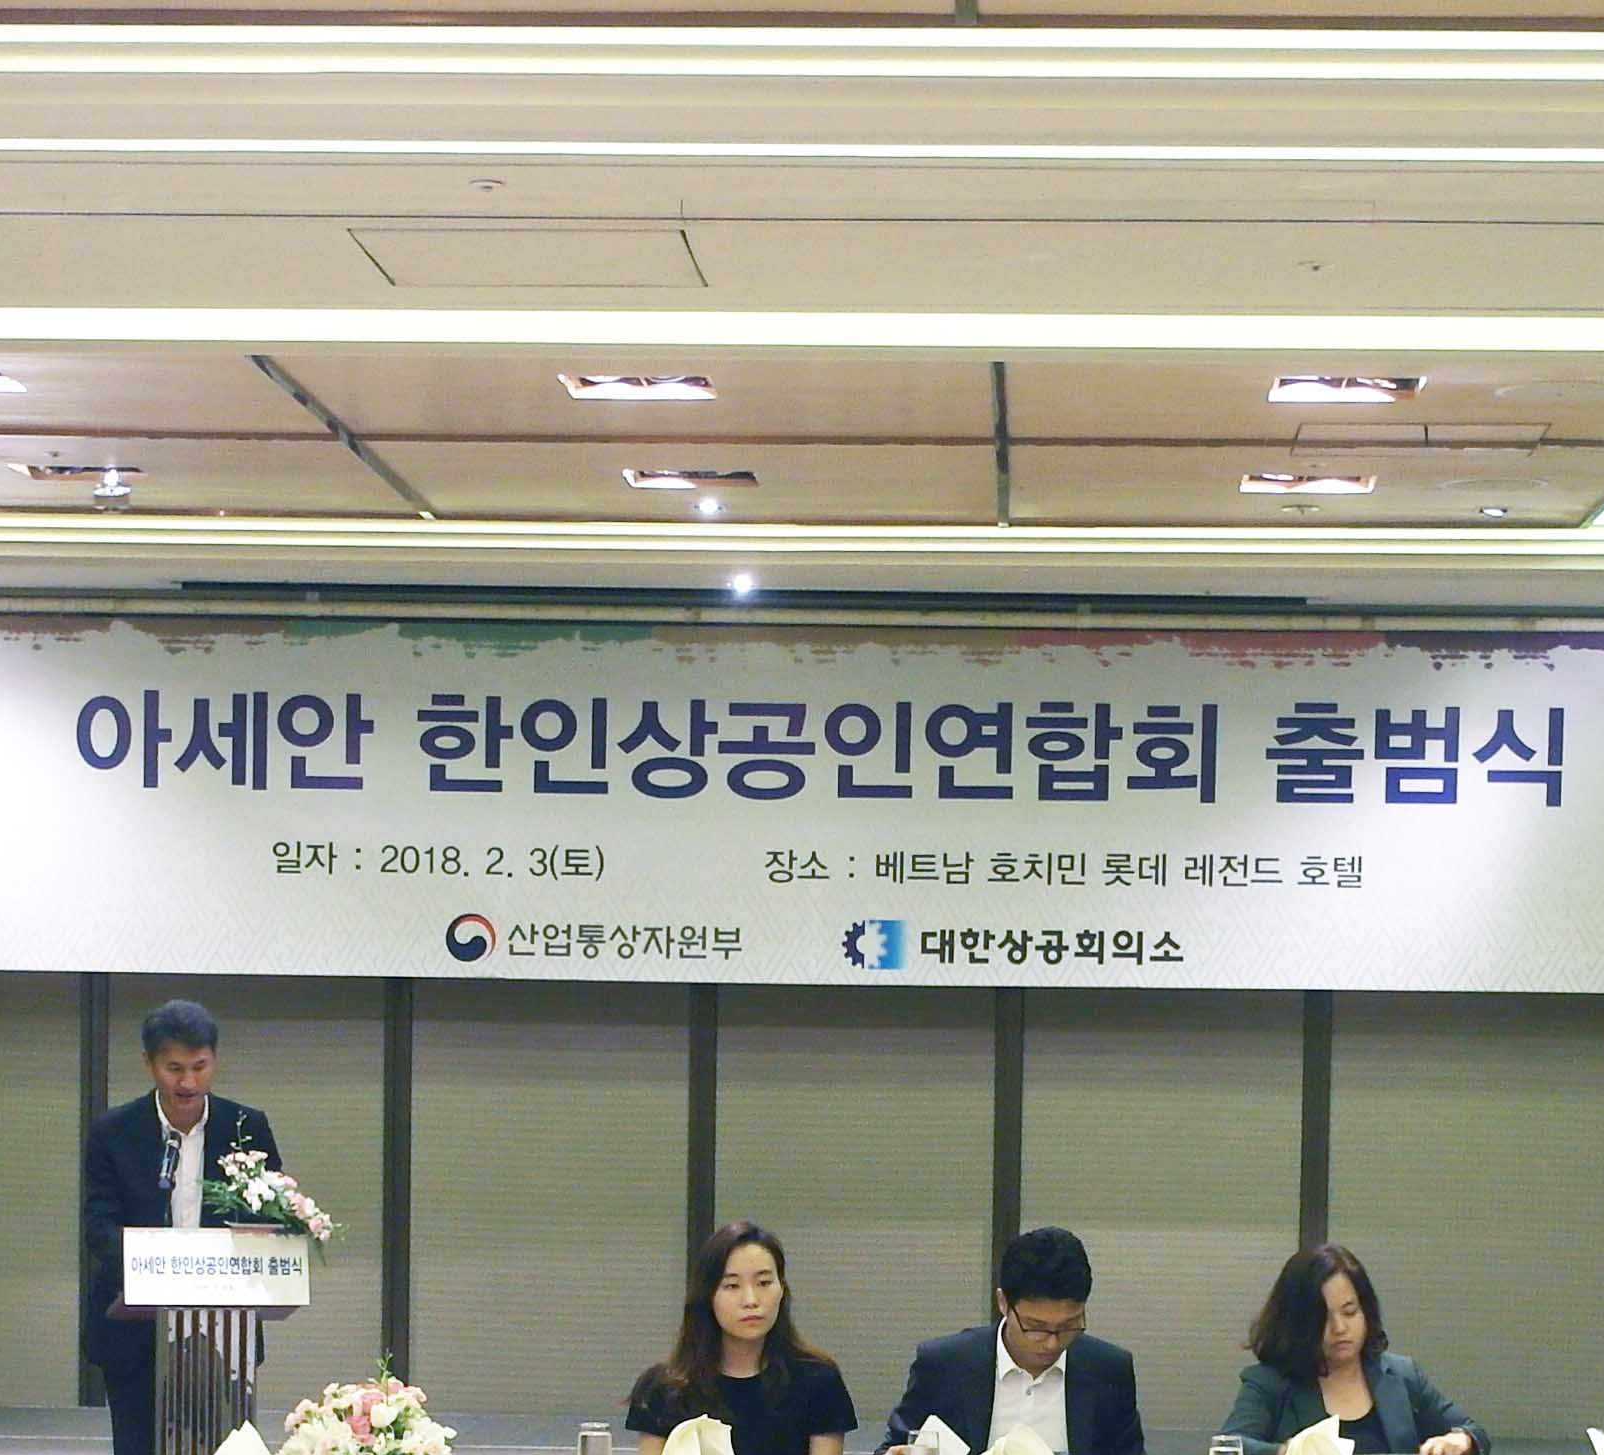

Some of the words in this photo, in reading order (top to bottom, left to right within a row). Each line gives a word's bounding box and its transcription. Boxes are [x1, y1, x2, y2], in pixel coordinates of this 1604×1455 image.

[76, 689, 374, 791] 아세안
[416, 692, 1219, 804] 한인상공인연합회
[1264, 702, 1565, 808] 출범식
[272, 840, 338, 876] 일자
[379, 844, 470, 878] 2018.
[484, 846, 514, 879] 2.
[528, 844, 605, 883] 3(토)
[764, 848, 831, 884] 장소
[875, 850, 974, 886] 베트남
[986, 851, 1087, 887] 호치민
[1101, 852, 1168, 888] 롯데
[1183, 852, 1284, 888] 레전드
[1296, 853, 1363, 889] 호텔
[507, 922, 743, 961] 산업통상자원부
[919, 927, 1185, 966] 대한상공회의소
[131, 1256, 165, 1275] 아세안
[170, 1255, 264, 1276] 한인상공인연합회
[267, 1256, 302, 1276] 출범식
